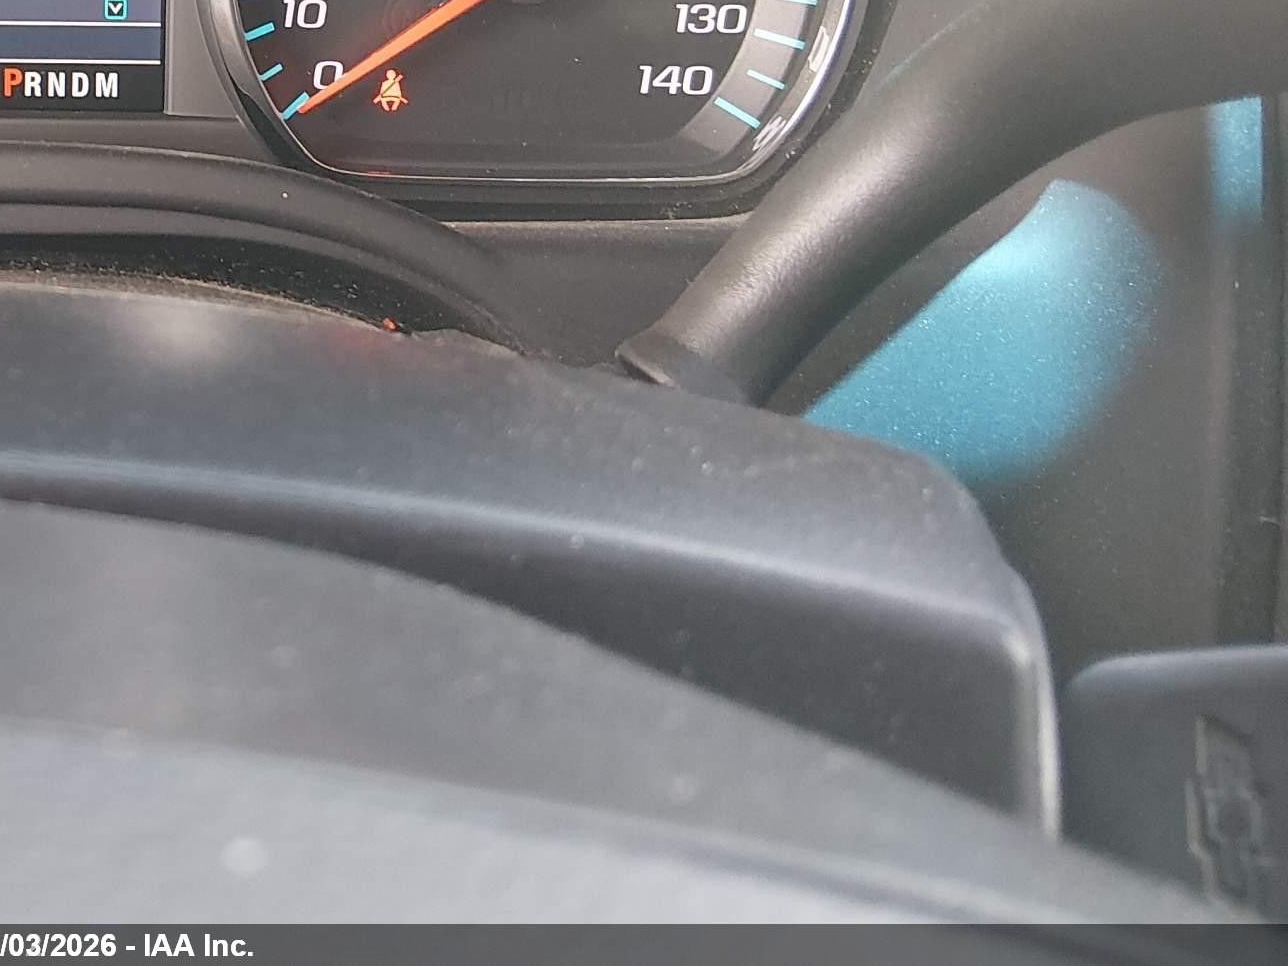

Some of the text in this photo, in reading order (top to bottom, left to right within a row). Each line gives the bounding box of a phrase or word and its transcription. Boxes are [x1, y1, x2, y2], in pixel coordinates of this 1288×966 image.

[675, 3, 748, 34] 130
[313, 60, 344, 90] 0
[639, 65, 713, 95] 140
